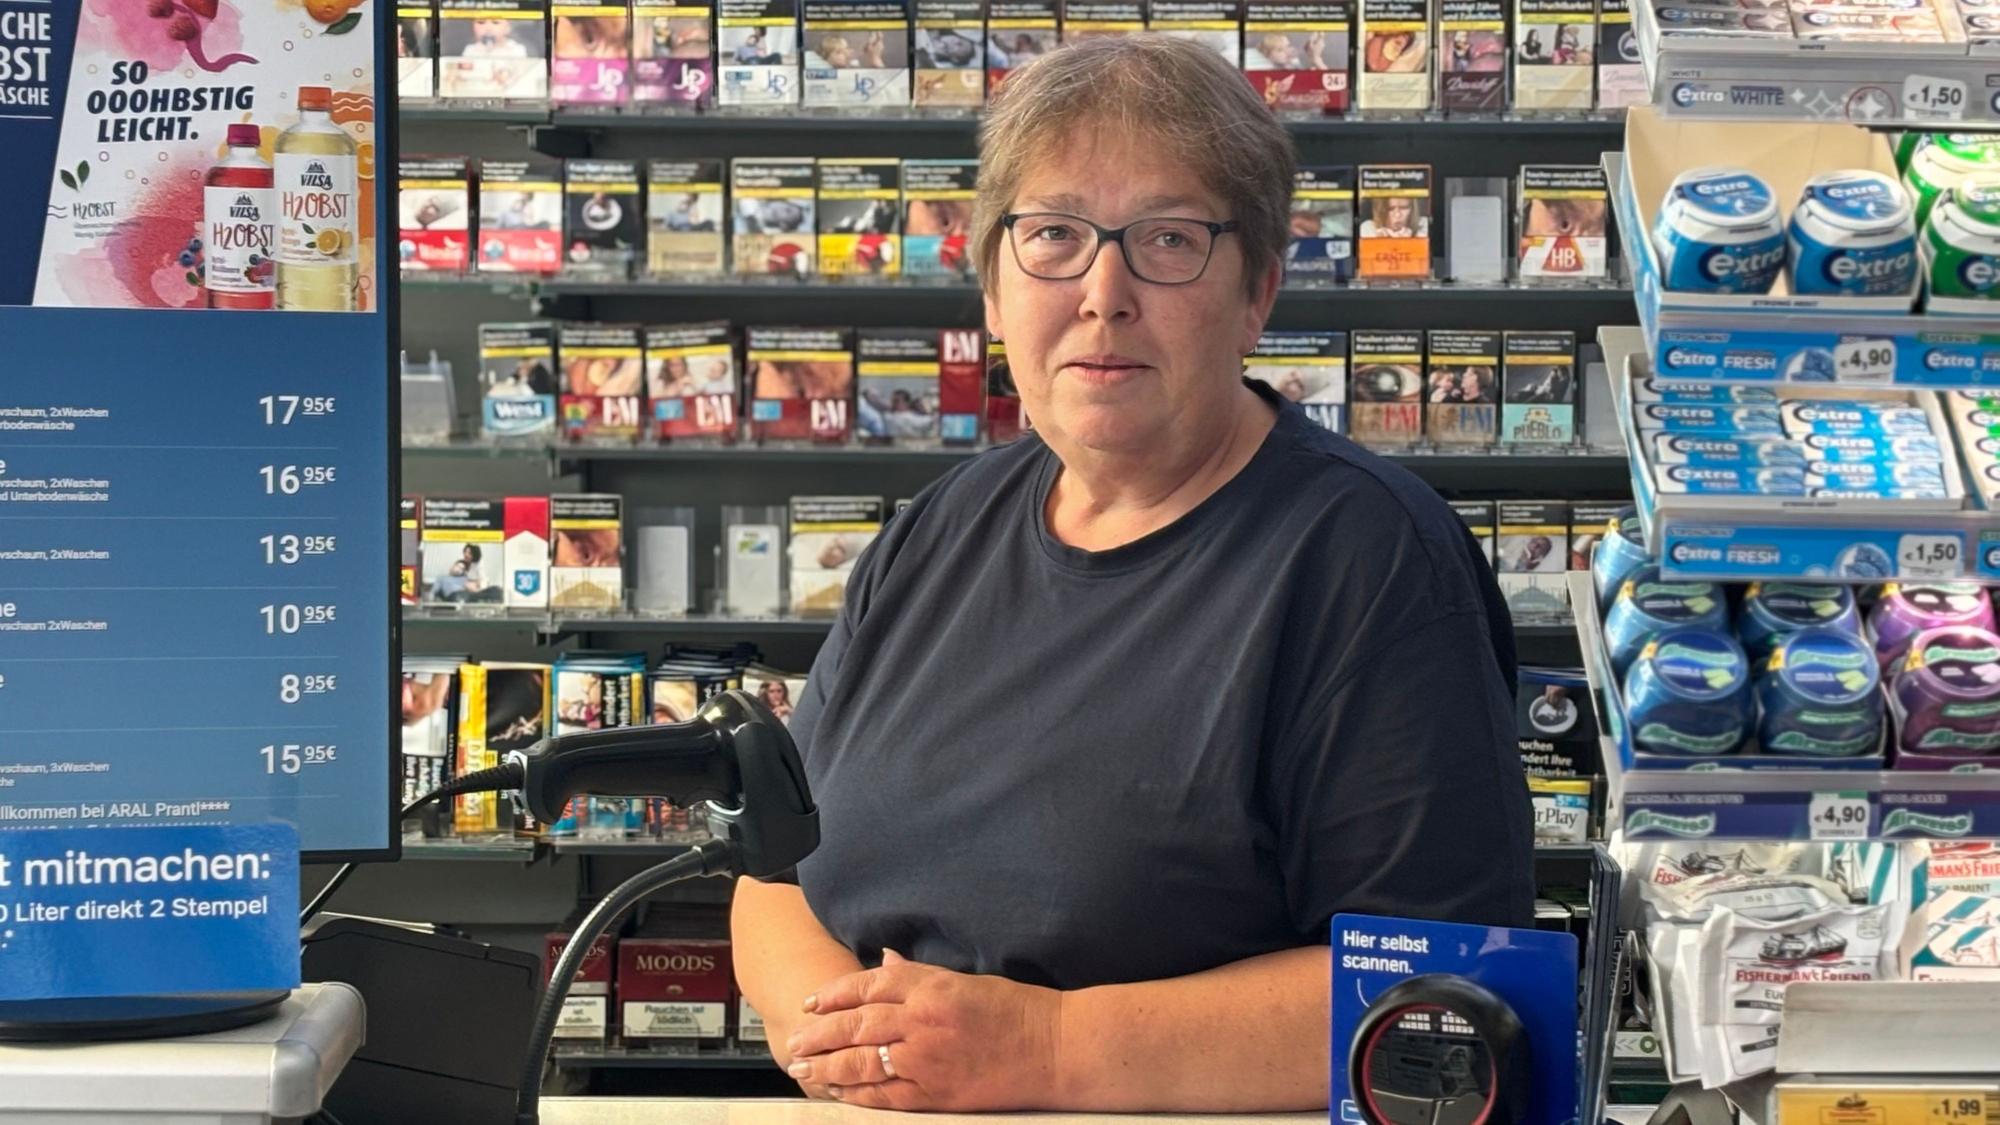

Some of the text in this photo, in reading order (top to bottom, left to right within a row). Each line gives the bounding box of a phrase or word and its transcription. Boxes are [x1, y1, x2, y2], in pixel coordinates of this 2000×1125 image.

[1, 11, 51, 41] CHE
[111, 61, 149, 85] SO
[87, 86, 254, 114] OOOHBSTIG
[1675, 87, 1785, 106] extra WHITE
[97, 117, 199, 143] LEICHT.
[1552, 248, 1576, 268] HB
[1707, 246, 1784, 277] extra
[1830, 251, 1910, 280] extra
[1668, 348, 1776, 369] extra FRESH
[1926, 351, 1976, 368] extra
[50, 407, 109, 418] 2xWaschen
[259, 395, 300, 425] 17
[1513, 420, 1562, 440] PUEBLO
[50, 478, 109, 489] 2xWaschen
[259, 465, 300, 494] 16
[11, 490, 109, 501] Unterbodenwäsche
[50, 549, 109, 560] 2xWaschen
[259, 534, 300, 564] 13
[1673, 544, 1780, 565] extra FRESH
[48, 619, 107, 630] 2xWaschen
[260, 604, 300, 634] 10
[280, 674, 300, 704] 8
[50, 762, 110, 773] 3xWaschen
[260, 744, 301, 774] 15
[1551, 755, 1573, 767] Ihre
[81, 803, 105, 818] bei
[107, 802, 152, 818] ARAL
[1546, 807, 1578, 826] Play
[24, 847, 271, 886] mitmachen:
[15, 902, 69, 922] Liter
[76, 898, 144, 920] direkt
[150, 898, 165, 918] 2
[172, 895, 268, 919] Stempel
[1343, 930, 1430, 954] Hier selbst
[636, 955, 715, 972] MOODS
[1342, 953, 1414, 974] scannen.
[1736, 968, 1818, 984] FISHERMAN'S
[644, 1004, 705, 1014] Rauchen ist
[656, 1015, 692, 1025] tödlich
